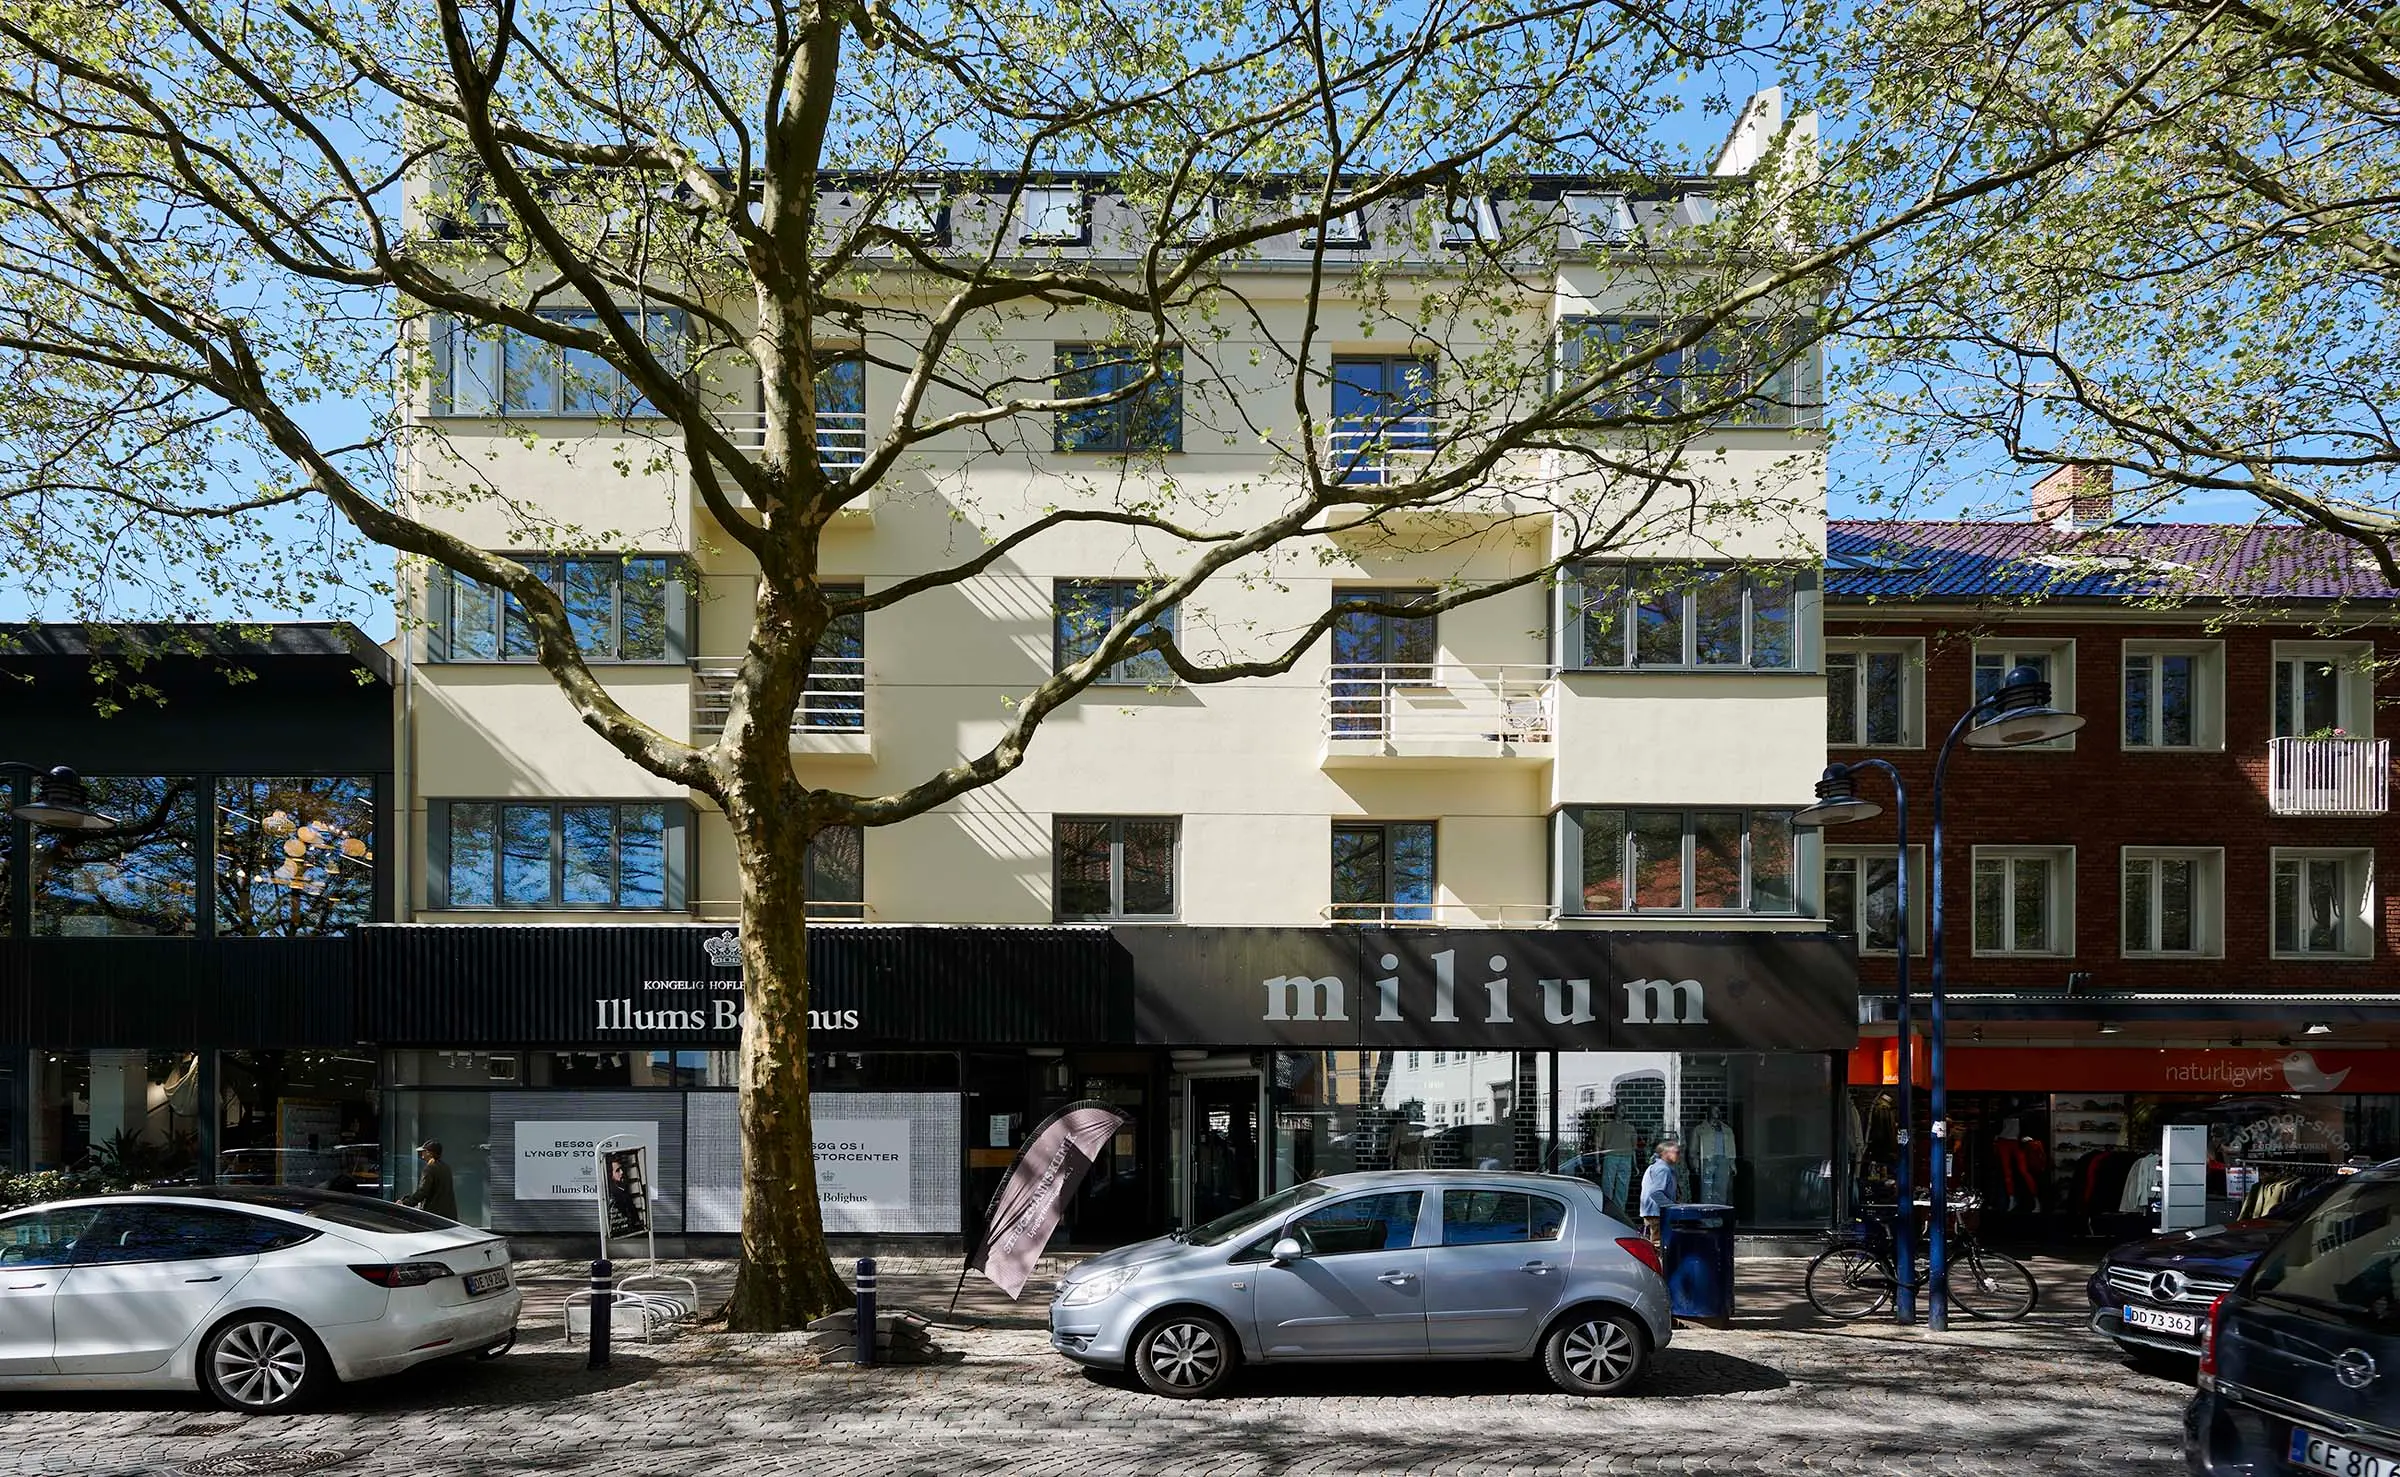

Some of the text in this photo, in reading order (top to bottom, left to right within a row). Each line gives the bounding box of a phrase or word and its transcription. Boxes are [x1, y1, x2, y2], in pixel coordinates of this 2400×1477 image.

[643, 980, 704, 990] KONGELIG
[1263, 948, 1709, 1026] milium
[595, 998, 705, 1030] Illums
[2165, 1060, 2274, 1088] naturligvis
[2229, 1114, 2351, 1152] OUTDOOR-SHOP
[554, 1140, 594, 1149] BESØG
[839, 1142, 858, 1151] OS
[524, 1150, 569, 1158] LYNGBY
[813, 1153, 900, 1161] STORCENTER
[552, 1184, 581, 1194] Illums
[823, 1192, 868, 1204] Bolighus
[2131, 1310, 2192, 1332] DD 73 362
[2308, 1439, 2340, 1471] CE
[2346, 1451, 2379, 1477] 80
